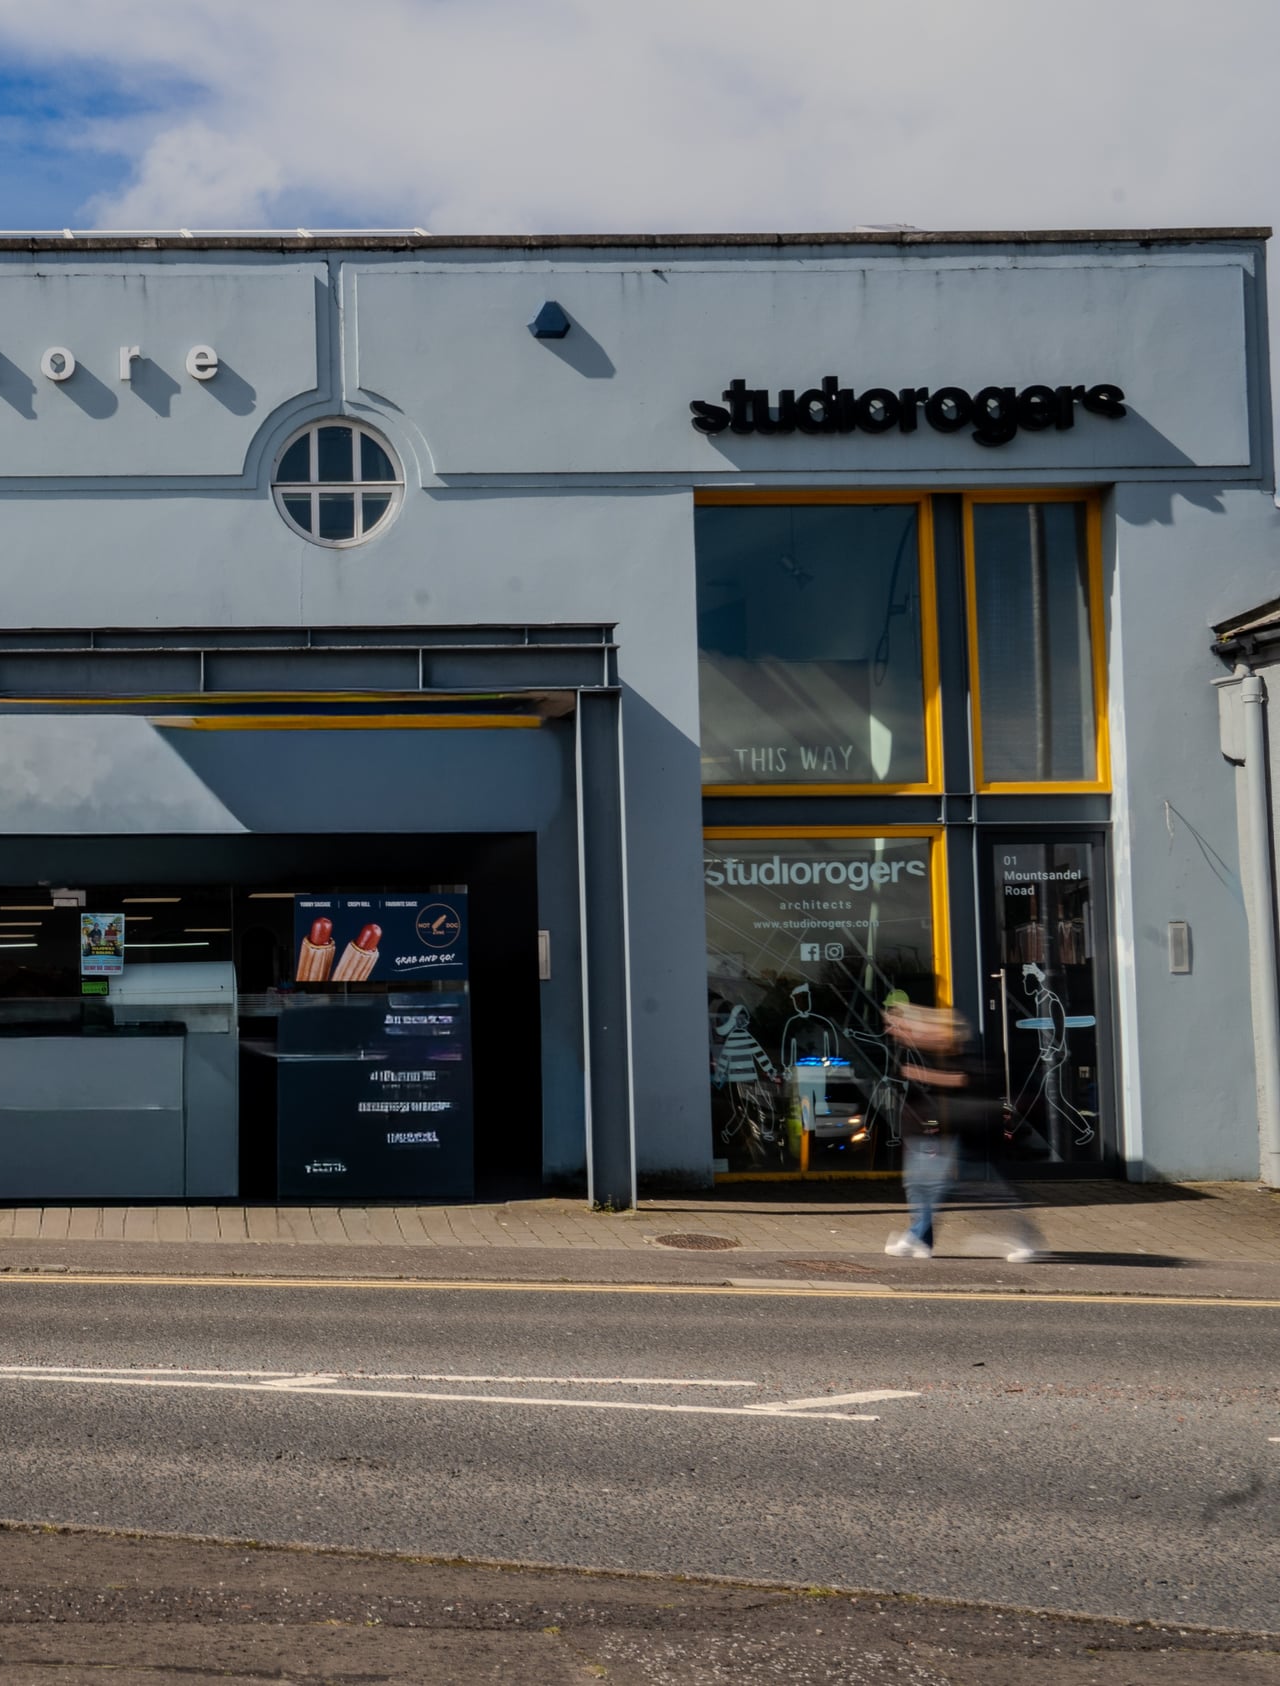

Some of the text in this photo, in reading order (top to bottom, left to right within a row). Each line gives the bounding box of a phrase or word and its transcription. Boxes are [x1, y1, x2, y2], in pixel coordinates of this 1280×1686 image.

[690, 376, 1126, 446] studiorogers
[733, 745, 854, 773] THIS WAY
[1003, 855, 1017, 866] 01
[705, 856, 926, 891] studiorogers
[1004, 869, 1082, 881] Mountsandel
[1005, 884, 1035, 896] Road
[779, 899, 852, 911] architects
[753, 918, 879, 931] www.studiorogers.com
[395, 955, 418, 966] GRAB
[418, 954, 438, 964] AND
